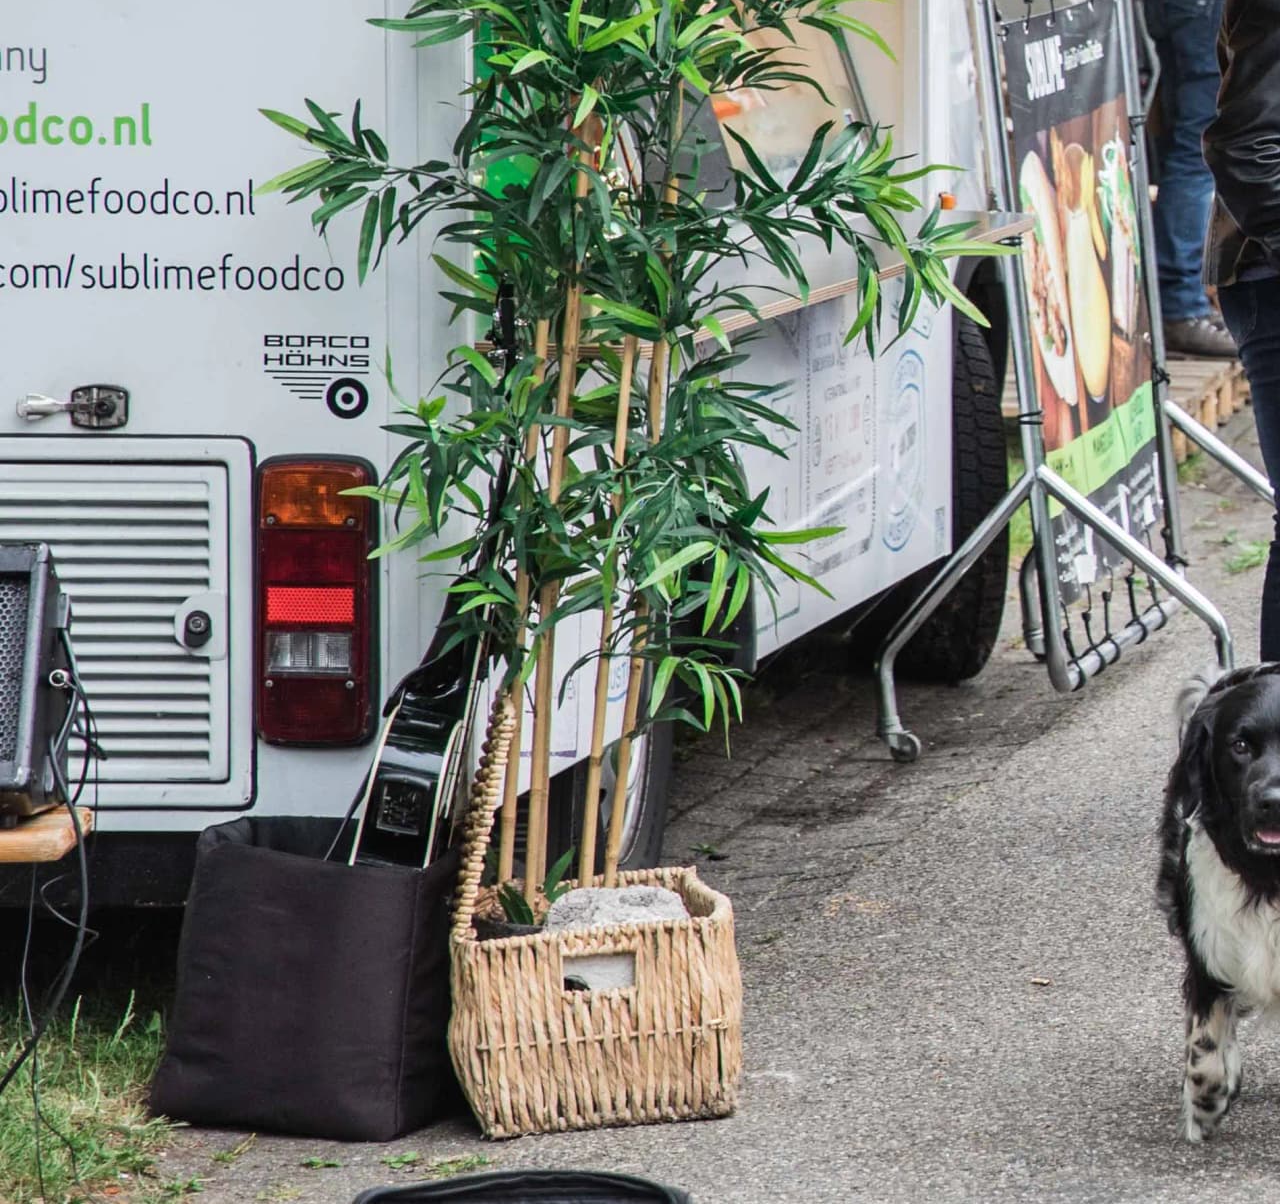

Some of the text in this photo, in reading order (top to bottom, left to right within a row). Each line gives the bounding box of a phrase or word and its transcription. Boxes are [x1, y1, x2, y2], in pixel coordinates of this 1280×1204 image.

[0, 46, 47, 84] ny
[264, 335, 369, 349] BORCO
[264, 350, 369, 367] HÖHNS
